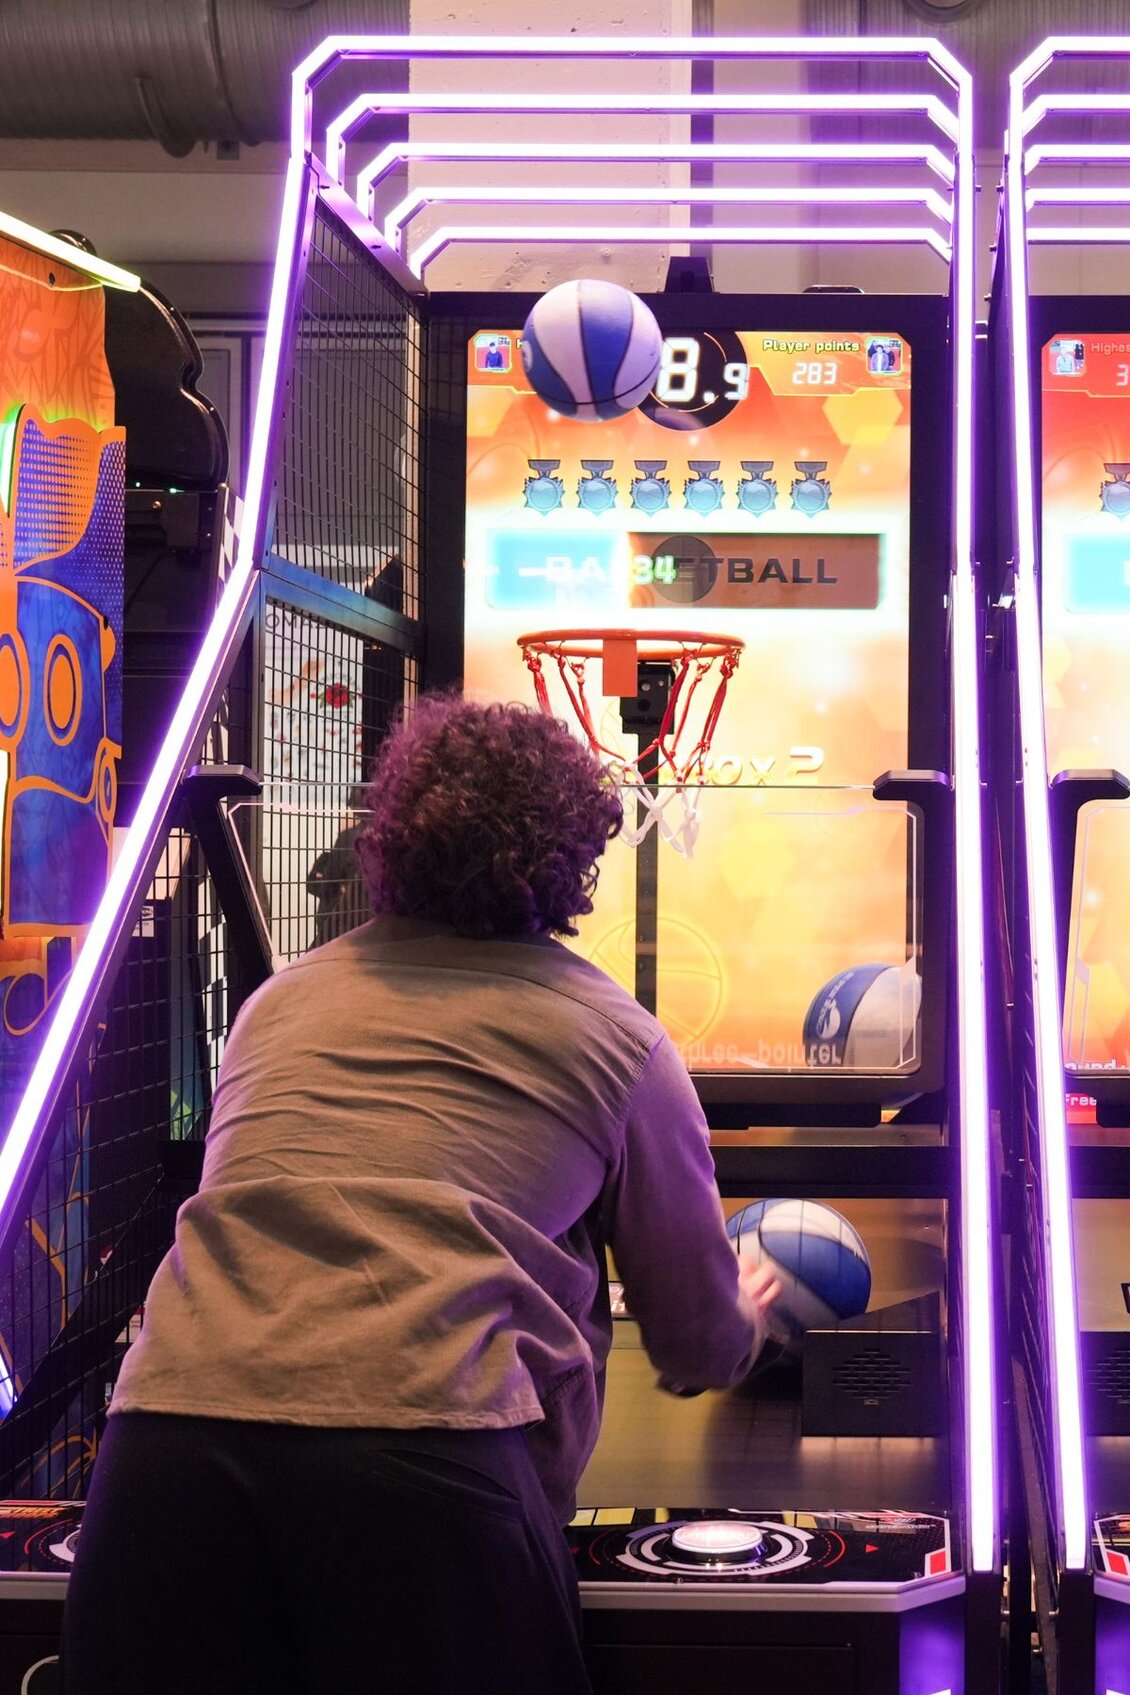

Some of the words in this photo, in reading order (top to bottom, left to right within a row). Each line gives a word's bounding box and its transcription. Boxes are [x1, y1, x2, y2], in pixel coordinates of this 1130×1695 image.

[763, 339, 810, 354] Player
[815, 340, 860, 354] points
[656, 337, 749, 403] 8.9
[792, 362, 838, 385] 283
[634, 555, 677, 585] 34
